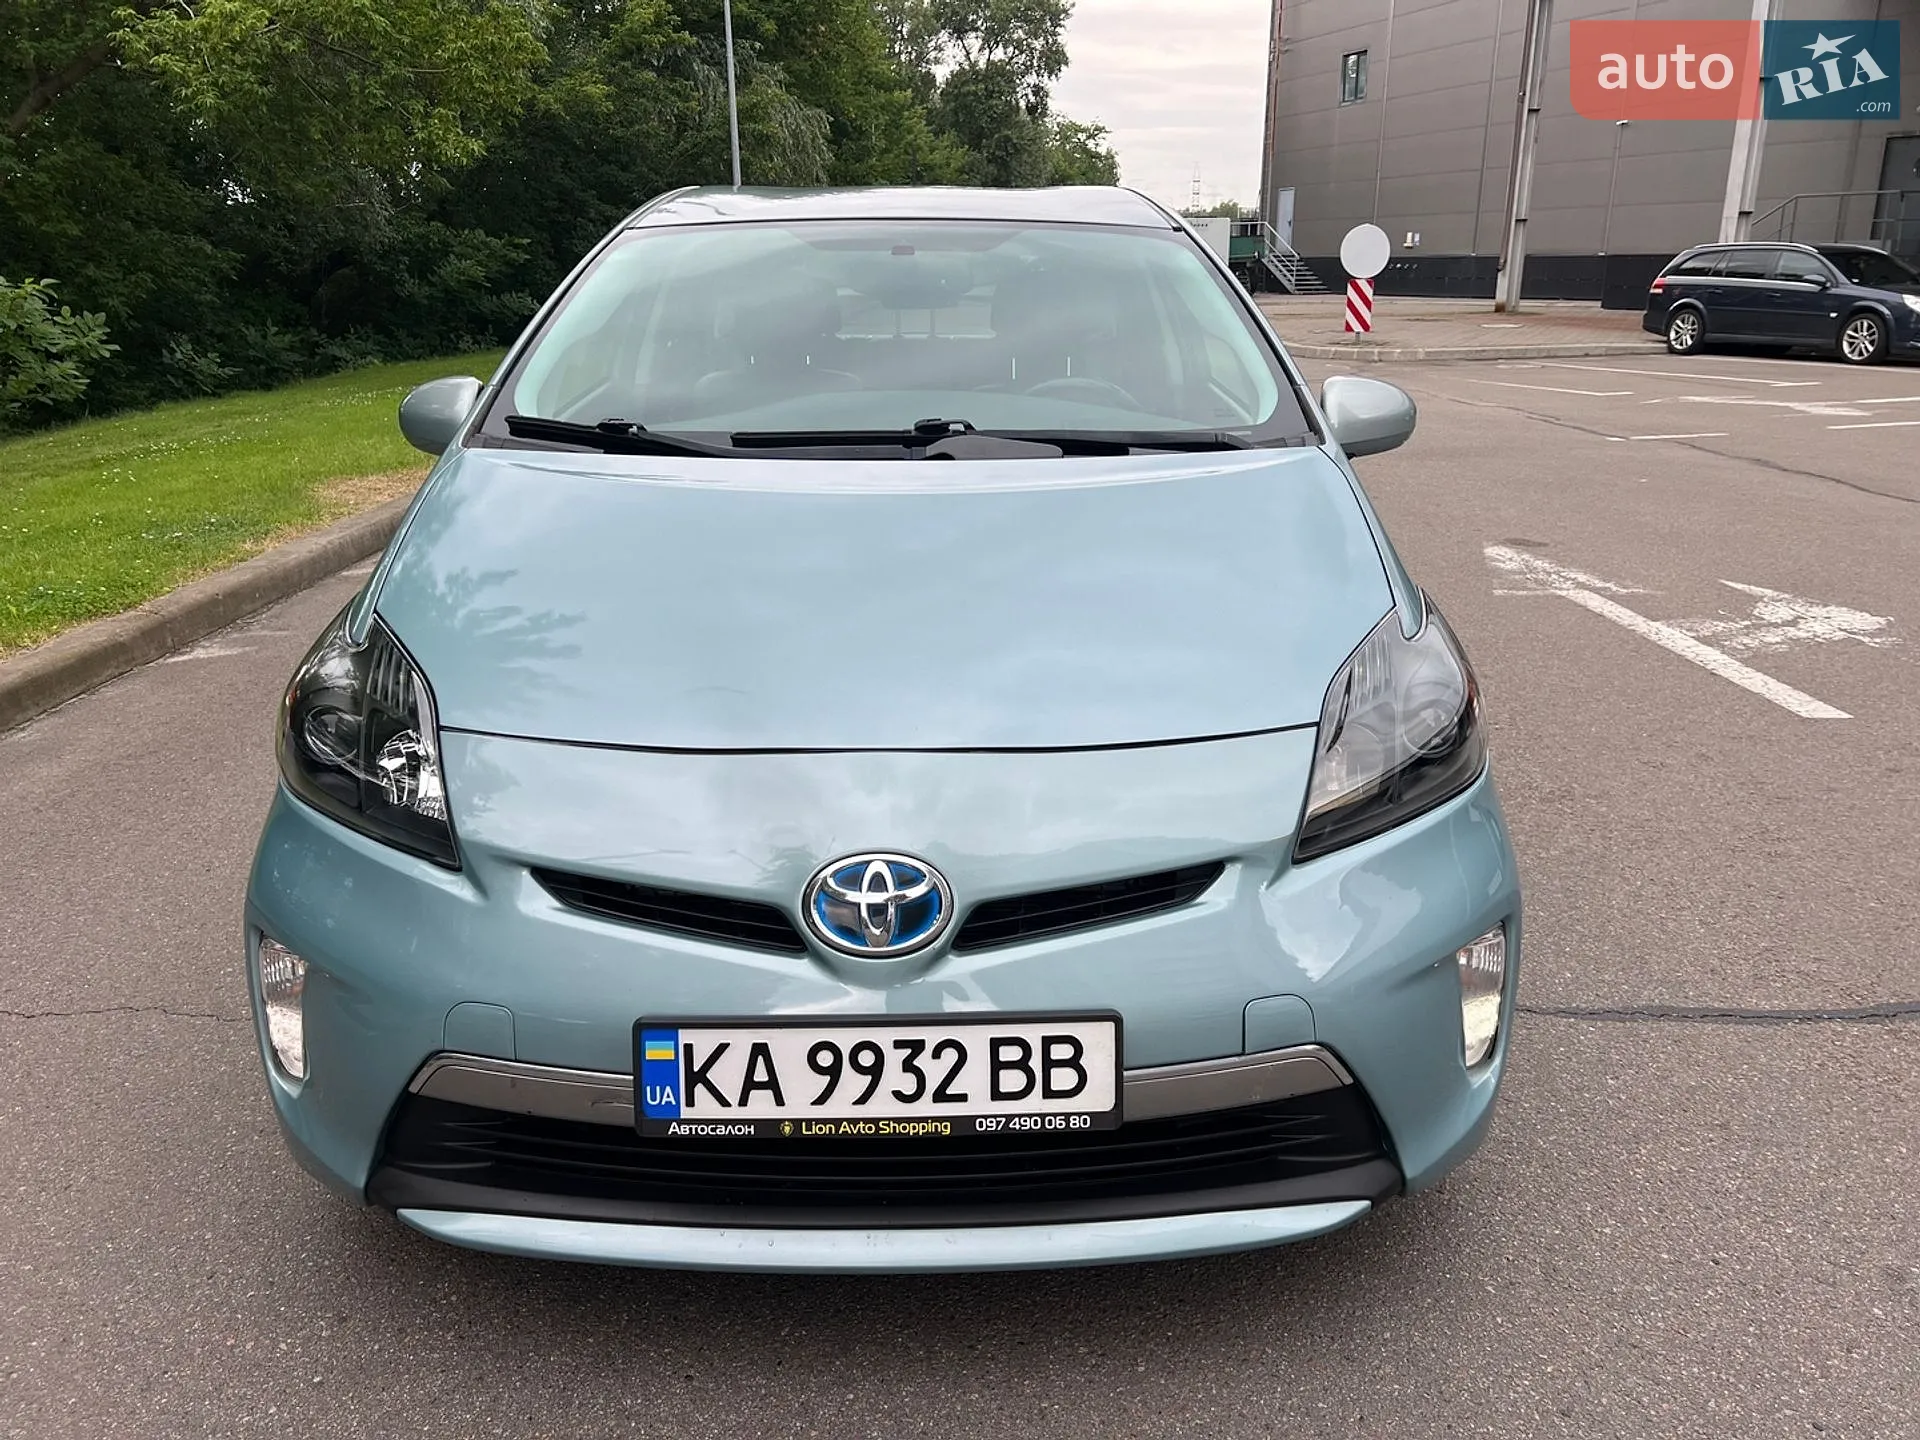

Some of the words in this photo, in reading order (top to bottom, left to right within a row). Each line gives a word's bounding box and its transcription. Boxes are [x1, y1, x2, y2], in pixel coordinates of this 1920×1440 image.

[683, 1041, 786, 1108] KA
[806, 1038, 968, 1106] 9932
[989, 1034, 1089, 1102] BB
[646, 1085, 676, 1106] UA
[668, 1121, 755, 1136] Автосалон
[802, 1121, 836, 1135] Lion
[838, 1121, 876, 1135] Avto
[878, 1119, 951, 1136] Shopping
[975, 1117, 1007, 1132] 097
[1009, 1116, 1041, 1131] 490
[1044, 1116, 1066, 1130] 06
[1069, 1114, 1091, 1129] 80
